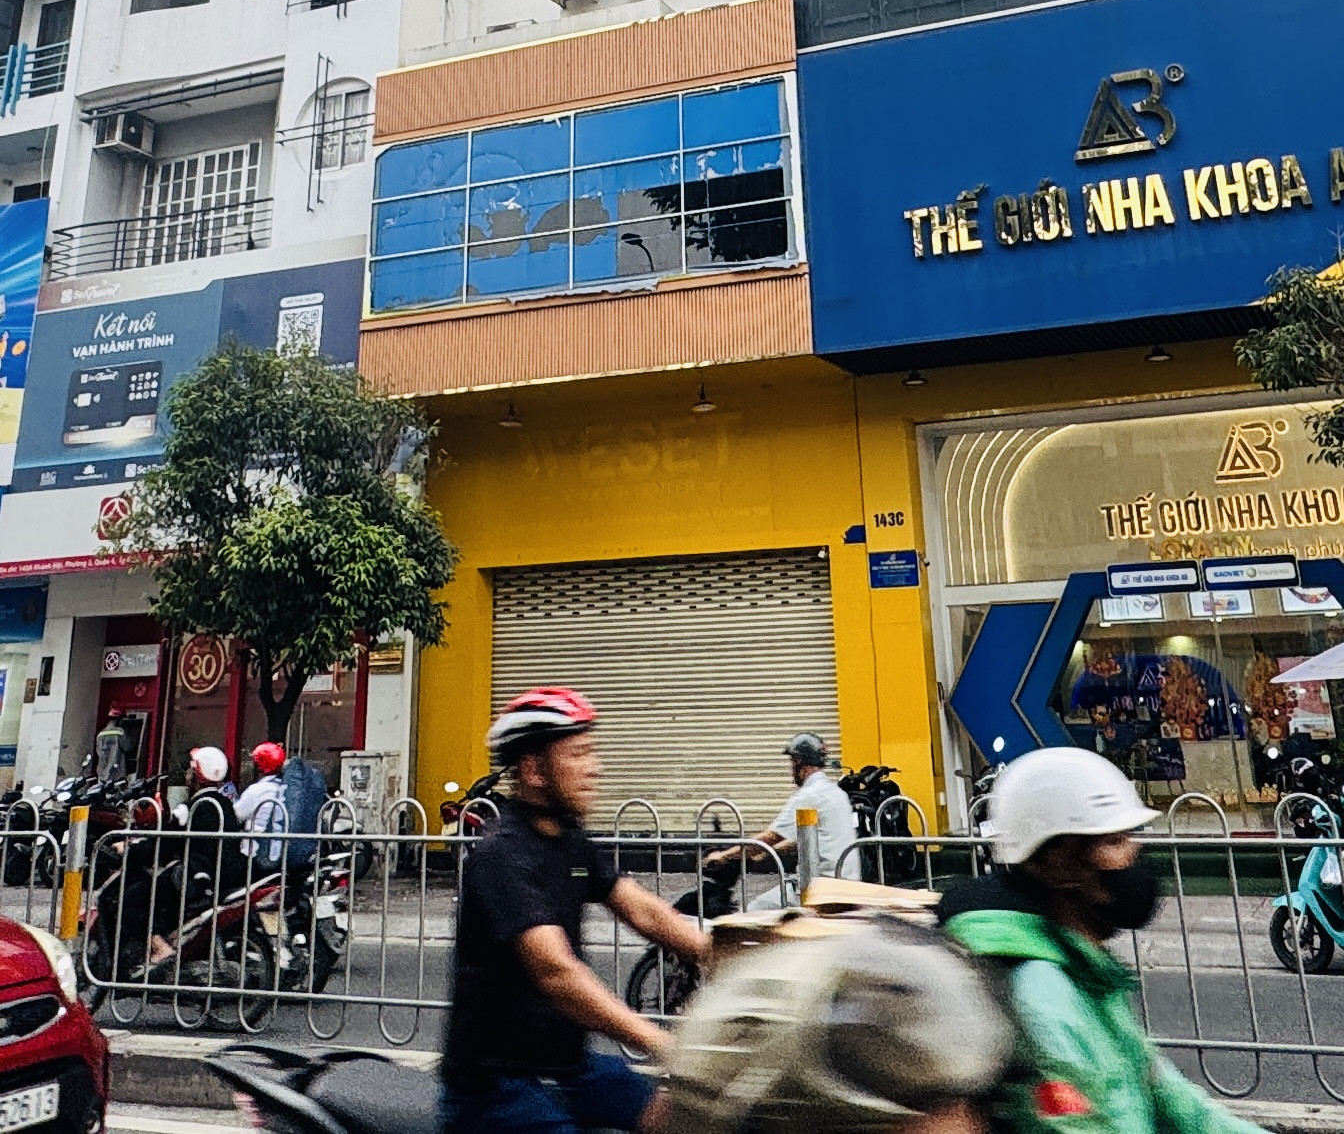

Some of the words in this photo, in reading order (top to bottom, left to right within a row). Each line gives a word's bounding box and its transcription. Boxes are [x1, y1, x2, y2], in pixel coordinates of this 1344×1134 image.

[903, 182, 987, 258] THẾ
[993, 177, 1074, 246] GIỚI
[1082, 173, 1175, 234] NHA
[1183, 154, 1313, 221] KHOA
[94, 311, 127, 339] Kết
[129, 309, 157, 333] nối
[72, 344, 98, 361] VẠN
[100, 337, 134, 355] HÀNH
[137, 333, 174, 351] TRÌNH
[874, 511, 905, 528] 143C
[1101, 492, 1156, 539] THẾ
[1158, 490, 1213, 536] GIỚI
[1215, 493, 1278, 533] NHA
[188, 654, 216, 682] 30
